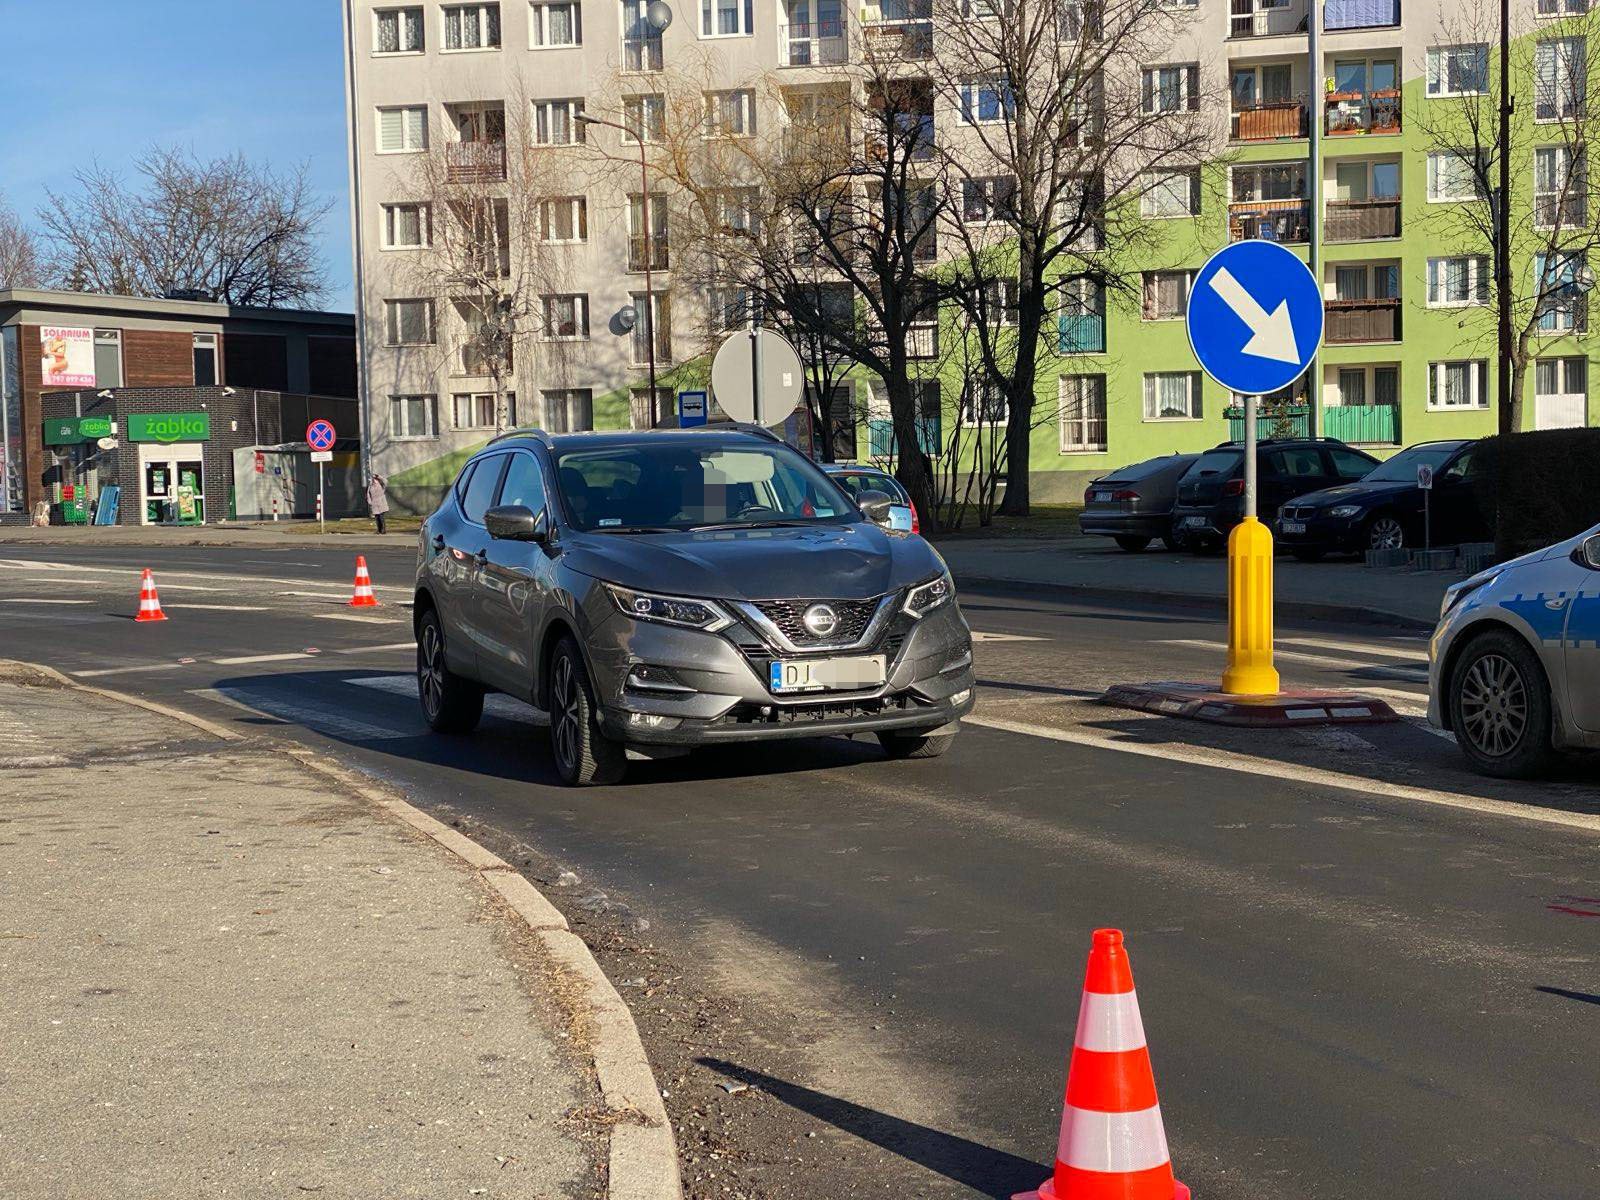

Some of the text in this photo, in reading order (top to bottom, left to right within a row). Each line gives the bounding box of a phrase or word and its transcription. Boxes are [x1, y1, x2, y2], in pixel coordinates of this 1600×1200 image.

[43, 329, 90, 338] SOLARIUM
[85, 421, 110, 431] żabka
[146, 418, 204, 434] żabka
